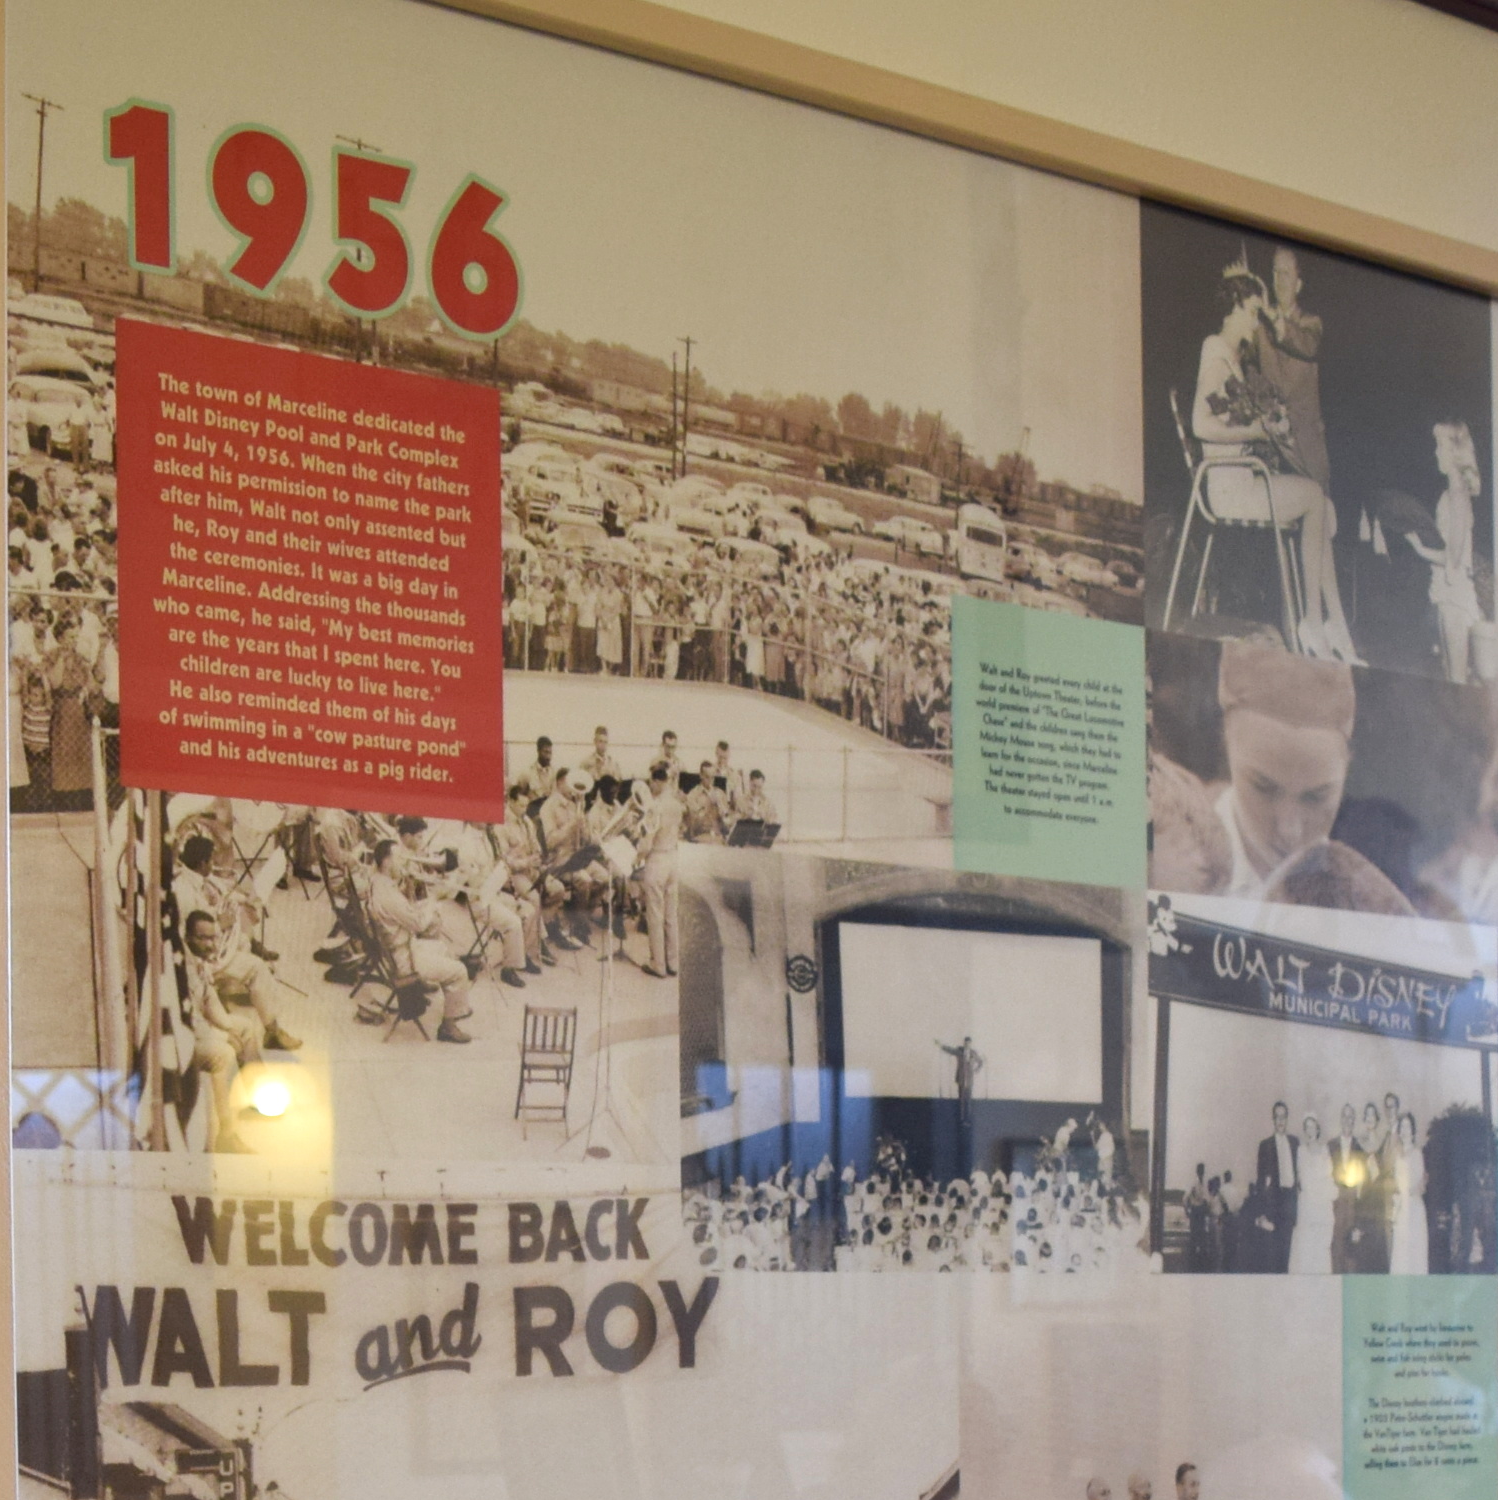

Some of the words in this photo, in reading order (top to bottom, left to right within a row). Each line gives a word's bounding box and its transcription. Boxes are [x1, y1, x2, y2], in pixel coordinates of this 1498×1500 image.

[104, 98, 522, 340] 1956
[157, 371, 189, 394] The
[194, 380, 238, 403] town
[243, 389, 262, 407] of
[266, 391, 347, 423] Marceline
[352, 408, 435, 438] dedicated
[439, 423, 465, 444] the
[160, 399, 198, 423] Walt
[204, 408, 259, 437] Disney
[265, 419, 303, 442] Pool
[309, 431, 340, 448] and
[345, 433, 382, 455] Park
[387, 441, 458, 469] Complex
[152, 457, 203, 479] asked
[209, 464, 232, 484] his
[237, 473, 327, 499] permission
[331, 486, 350, 503] to
[354, 492, 398, 511] name
[404, 497, 429, 516] the
[435, 505, 471, 523] park
[154, 431, 177, 447] on
[182, 432, 216, 457] July
[222, 440, 239, 461] 4,
[246, 444, 294, 467] 1956.
[300, 452, 346, 476] When
[351, 462, 377, 482] the
[382, 468, 411, 489] city
[416, 473, 470, 497] fathers
[159, 485, 200, 506] after
[206, 491, 243, 516] him,
[249, 498, 285, 520] Walt
[291, 509, 319, 525] not
[323, 513, 360, 534] only
[365, 520, 434, 543] assented
[439, 528, 466, 548] but
[172, 512, 199, 536] he,
[206, 518, 239, 543] Roy
[245, 528, 277, 545] and
[282, 532, 321, 552] their
[327, 539, 371, 560] wives
[375, 549, 449, 572] attended
[152, 595, 190, 615] who
[195, 604, 245, 626] came,
[251, 607, 272, 627] he
[277, 614, 315, 635] said,
[322, 618, 353, 641] "My
[358, 622, 392, 643] best
[397, 631, 474, 654] memories
[161, 566, 251, 596] Marceline.
[257, 581, 350, 614] Addressing
[355, 596, 381, 615] the
[386, 601, 466, 627] thousands
[169, 678, 193, 699] He
[199, 684, 232, 703] also
[237, 692, 320, 714] reminded
[325, 700, 367, 720] them
[371, 706, 389, 722] of
[394, 707, 415, 725] his
[420, 710, 456, 732] days
[179, 653, 250, 678] children
[255, 667, 282, 682] are
[288, 667, 331, 691] lucky
[336, 675, 353, 691] to
[359, 676, 387, 695] live
[393, 680, 441, 701] here."
[157, 706, 177, 724] of
[182, 711, 266, 738] swimming
[271, 719, 287, 737] in
[292, 725, 302, 739] a
[307, 724, 347, 744] "cow
[352, 732, 411, 751] pasture
[417, 739, 466, 757] pond"
[1213, 933, 1310, 992] WALT
[1269, 991, 1361, 1024] MUNICIPAL
[1368, 1009, 1413, 1032] PARK
[172, 1195, 479, 1266] WELCOME
[507, 1197, 650, 1263] BACK
[83, 1285, 327, 1388] WALT
[355, 1282, 482, 1391] and
[513, 1277, 719, 1377] ROY
